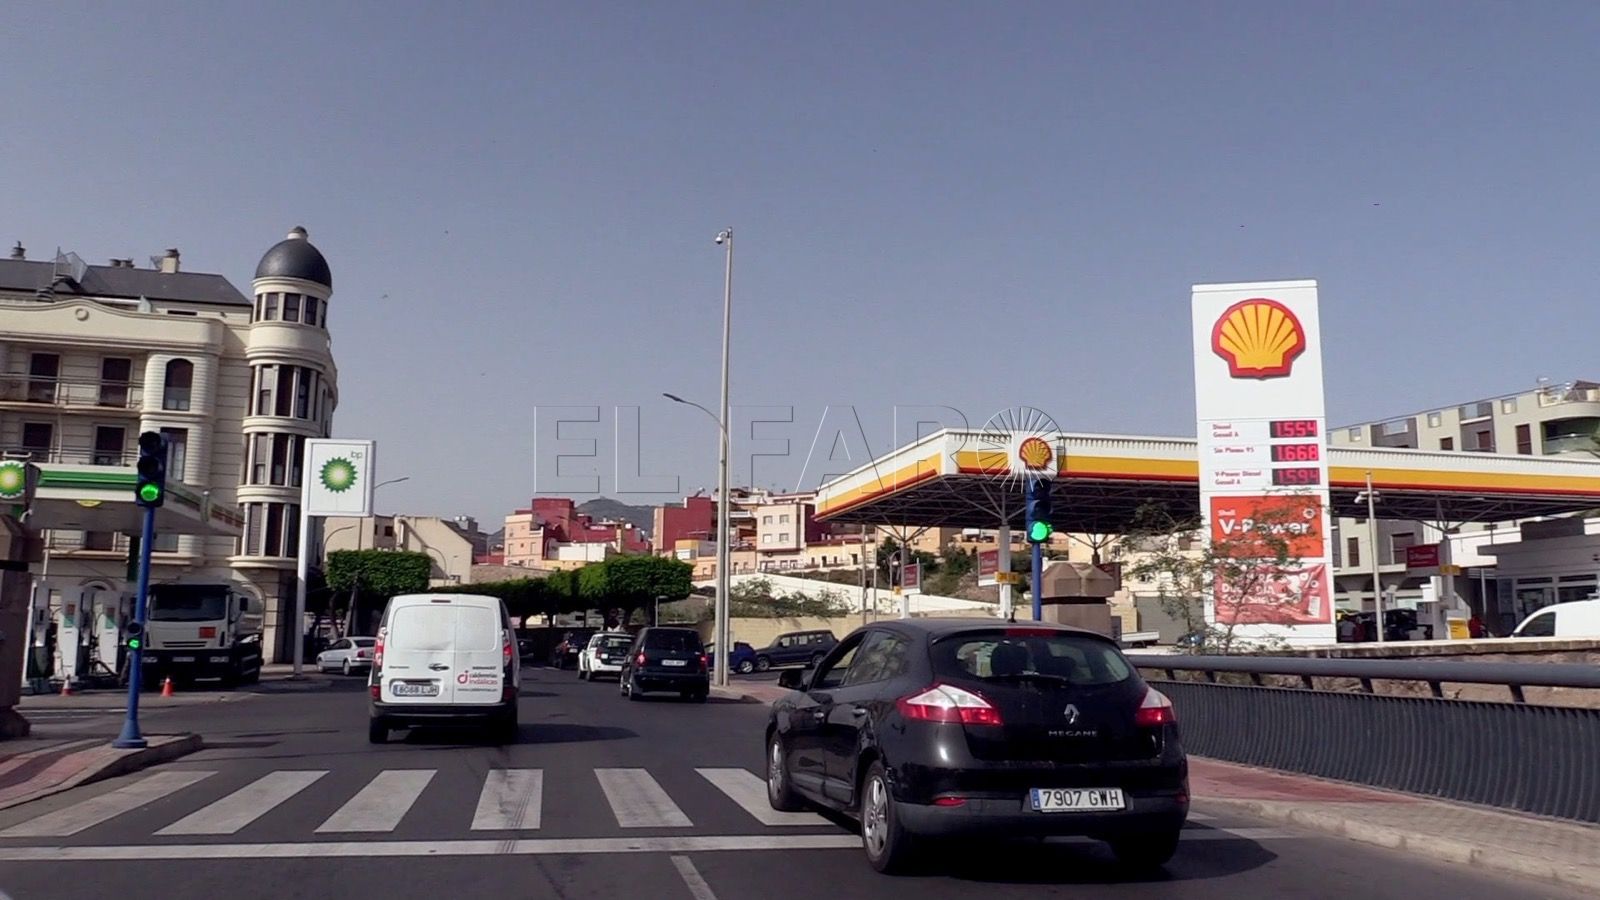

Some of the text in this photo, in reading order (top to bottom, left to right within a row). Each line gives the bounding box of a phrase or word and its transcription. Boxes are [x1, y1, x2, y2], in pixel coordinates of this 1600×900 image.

[350, 451, 363, 460] bp
[1042, 790, 1120, 806] 7907 GWH
